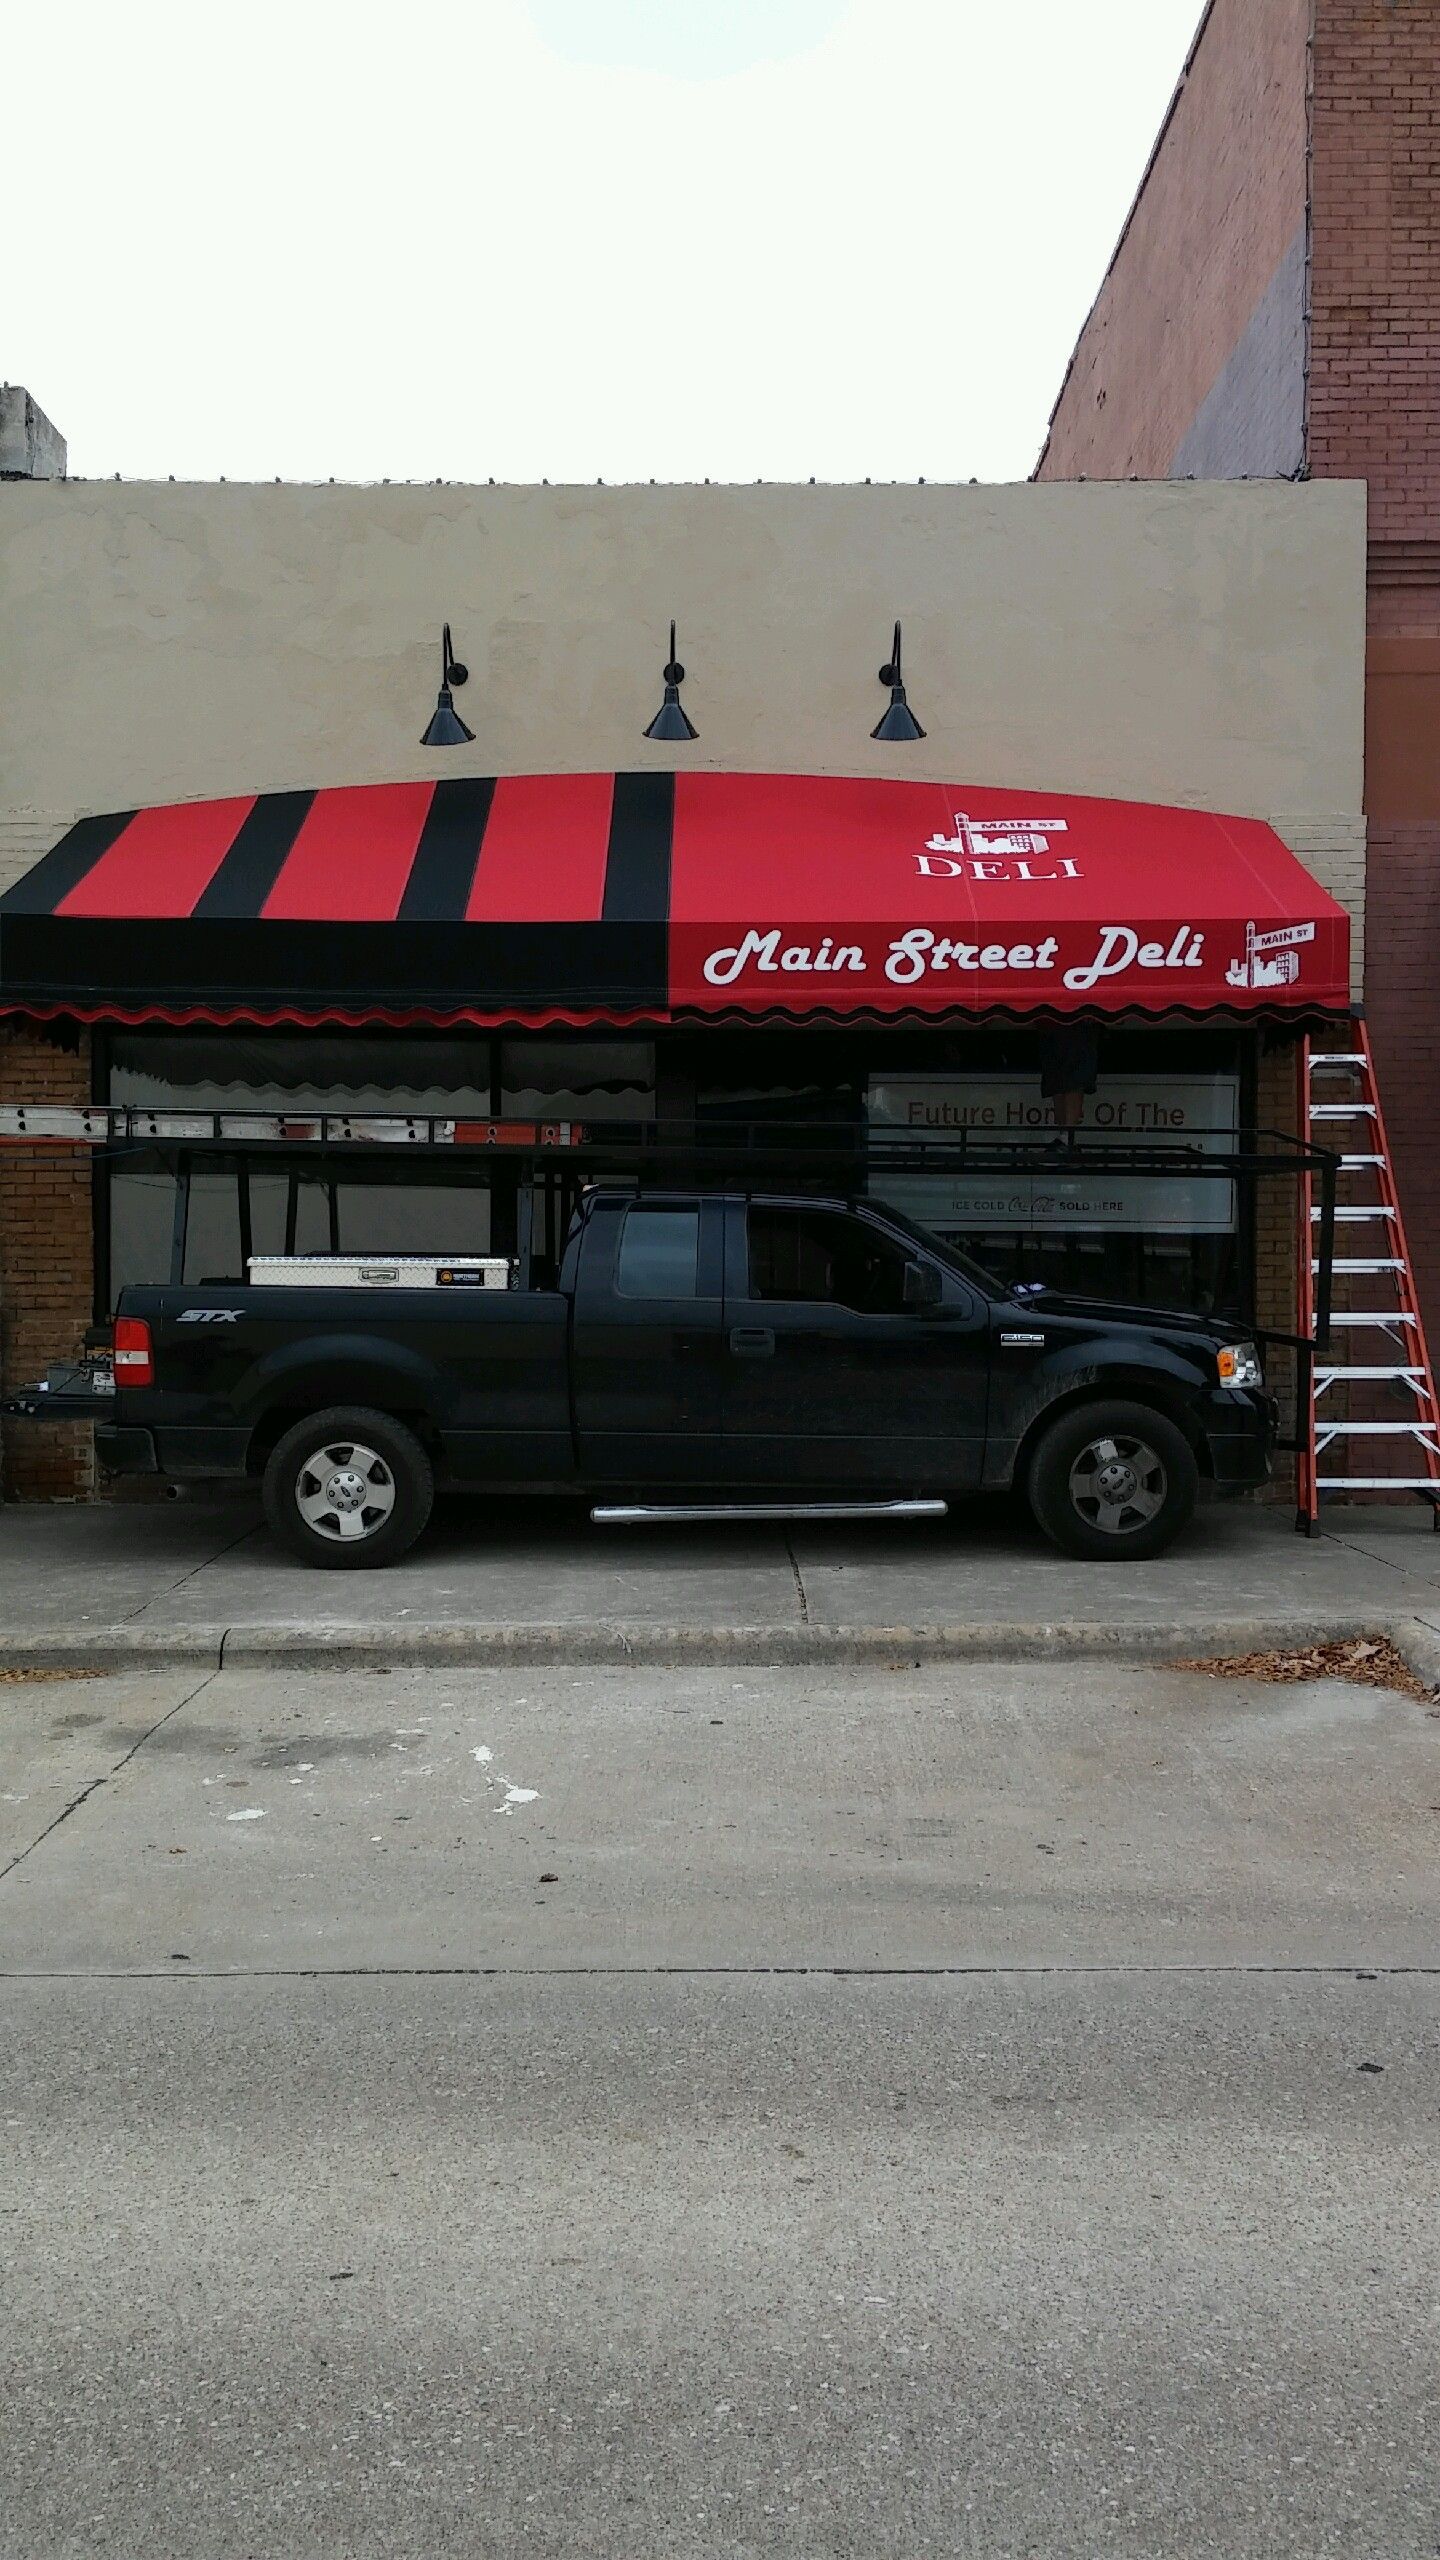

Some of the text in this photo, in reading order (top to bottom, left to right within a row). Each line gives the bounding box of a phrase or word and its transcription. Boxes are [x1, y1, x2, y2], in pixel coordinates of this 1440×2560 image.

[980, 821, 1032, 829] MAIN
[911, 852, 1085, 881] DELI
[1260, 928, 1309, 947] MAIN ST
[703, 925, 1205, 990] Main Street Deli
[908, 1101, 995, 1125] Future
[1094, 1102, 1127, 1125] Of
[1136, 1102, 1185, 1126] The
[952, 1201, 970, 1210] ICE
[973, 1201, 1005, 1210] COLD
[1059, 1201, 1090, 1211] SOLD
[1093, 1201, 1124, 1211] HERE
[177, 1309, 245, 1322] STX
